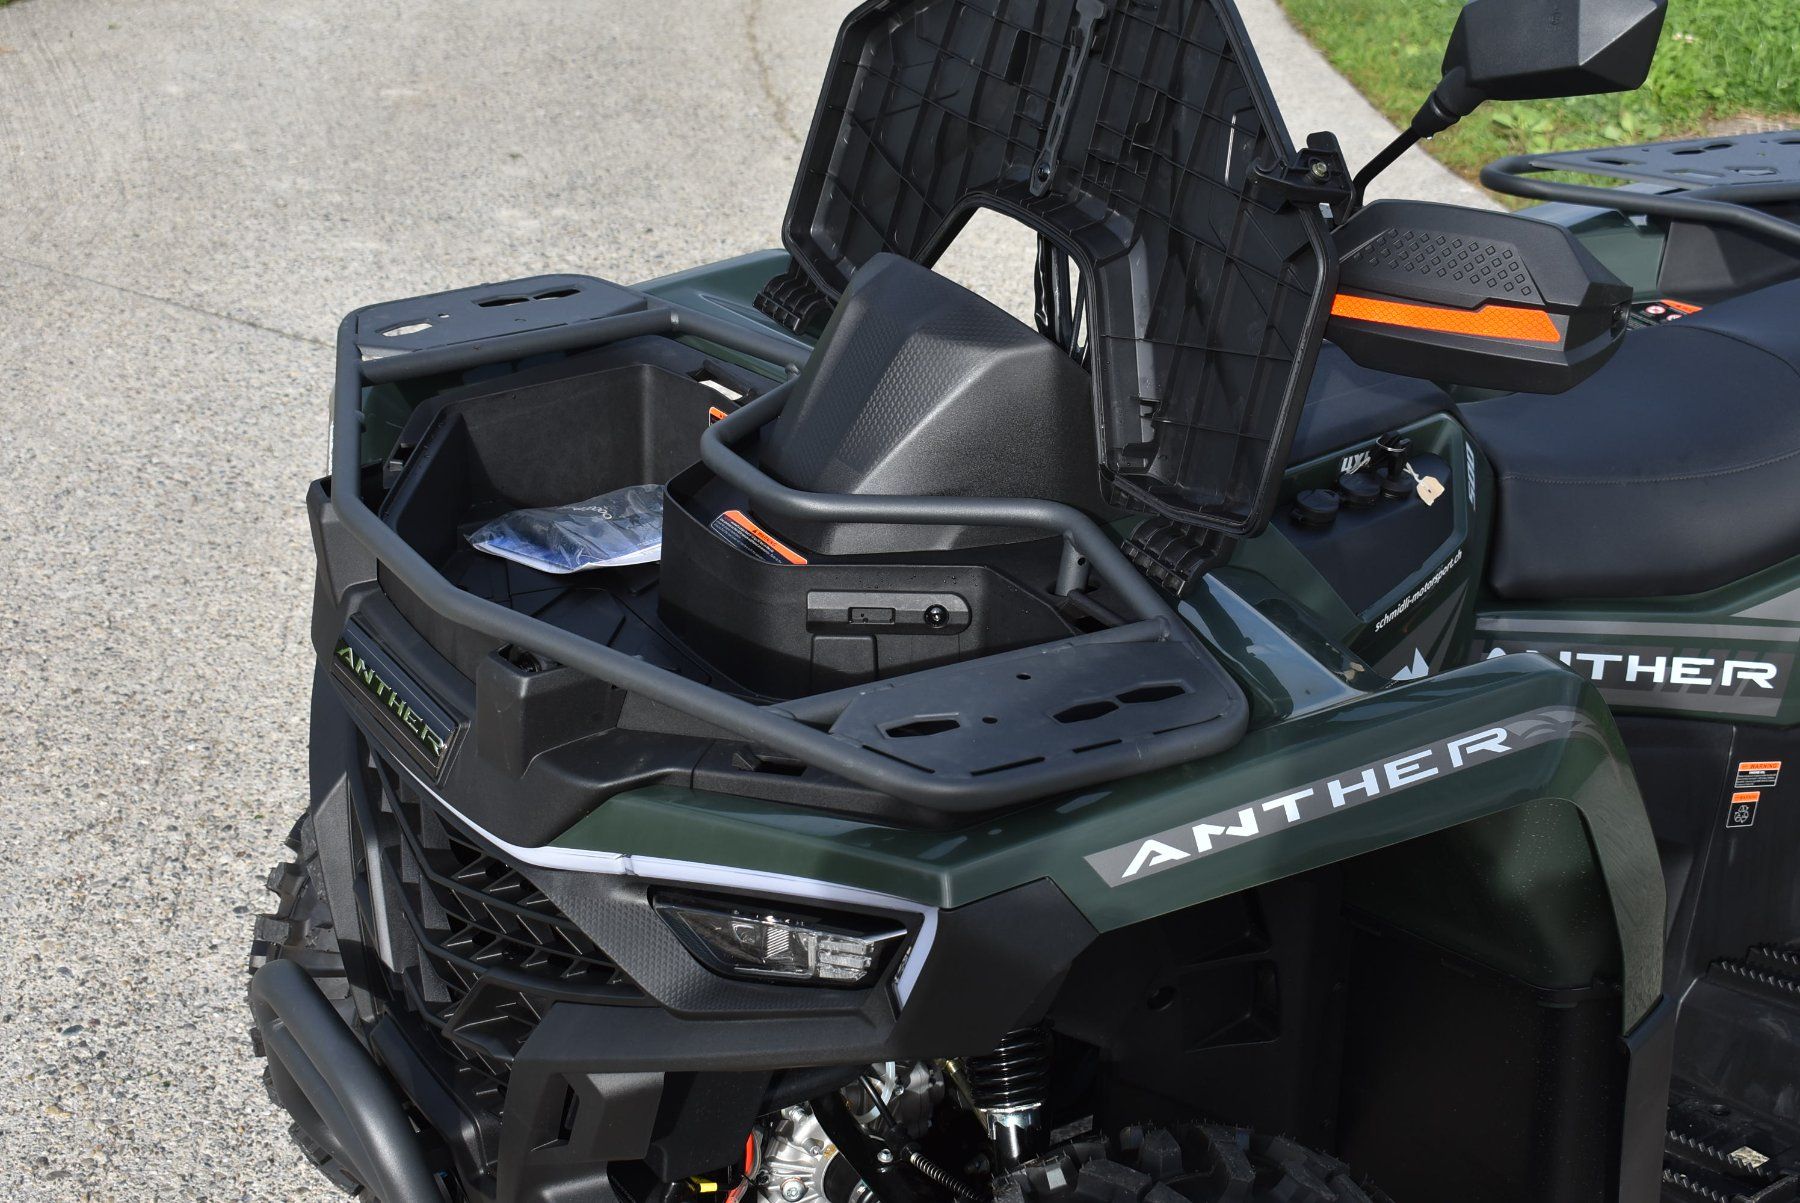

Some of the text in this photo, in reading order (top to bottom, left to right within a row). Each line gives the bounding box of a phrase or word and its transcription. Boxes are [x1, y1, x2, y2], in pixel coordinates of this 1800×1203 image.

[337, 647, 448, 757] ANTHER
[1486, 647, 1778, 690] THER
[1121, 727, 1513, 878] ANTHER
